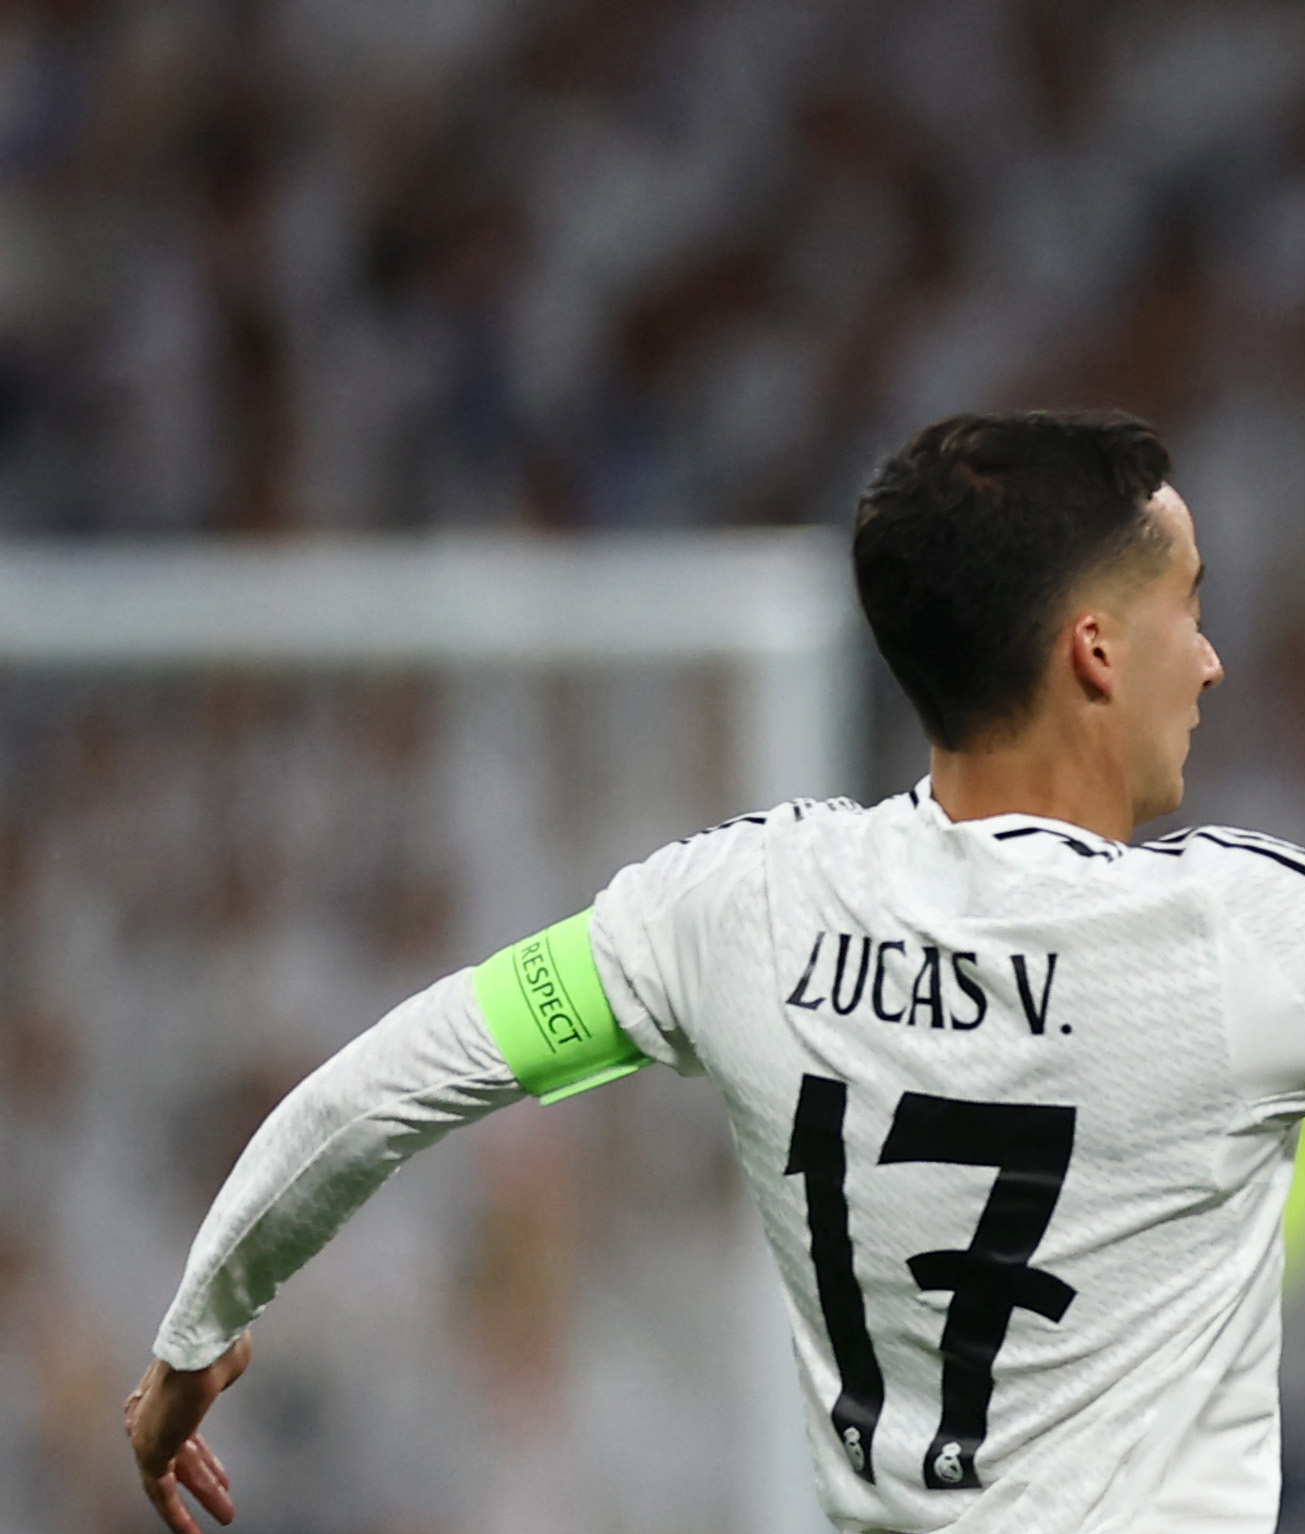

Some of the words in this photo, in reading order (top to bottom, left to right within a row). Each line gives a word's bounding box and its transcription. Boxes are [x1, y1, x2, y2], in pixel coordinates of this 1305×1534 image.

[519, 941, 583, 1045] RESPECT
[786, 931, 988, 1031] LUCAS
[1010, 952, 1073, 1035] V.
[784, 1073, 1078, 1490] 17
